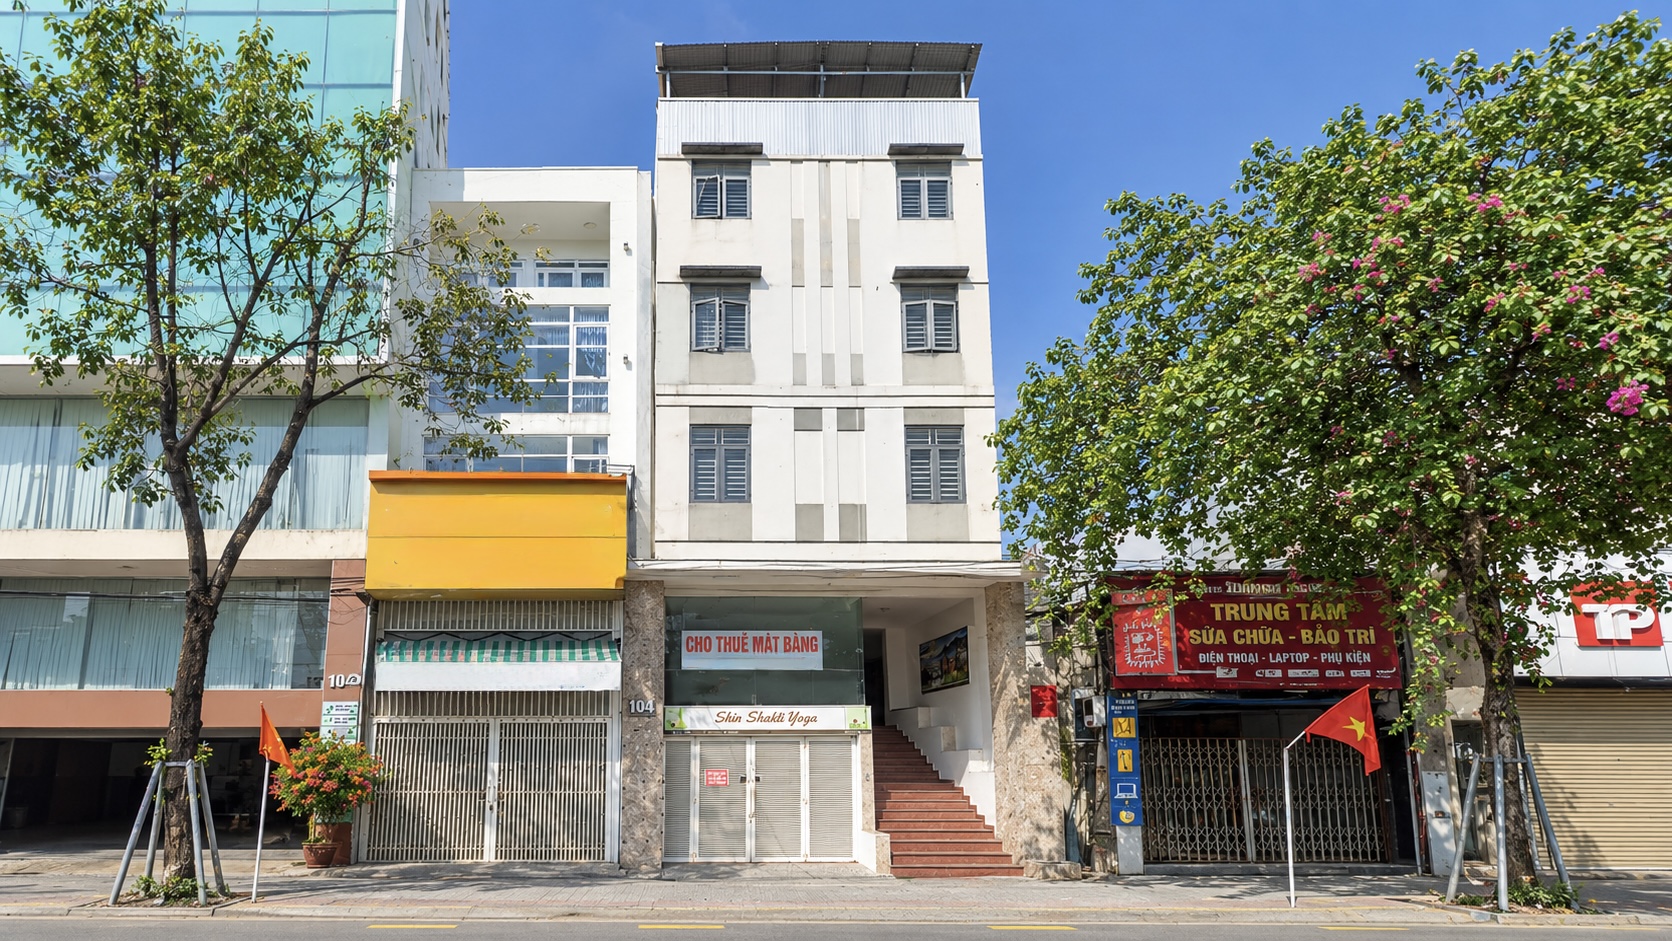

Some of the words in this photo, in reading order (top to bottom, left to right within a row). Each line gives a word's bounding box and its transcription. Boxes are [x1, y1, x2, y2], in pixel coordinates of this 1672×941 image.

[1210, 603, 1289, 620] TRUNG
[1581, 604, 1655, 639] TP
[1233, 626, 1284, 645] CHỮA
[686, 636, 713, 653] CHO
[1227, 653, 1258, 665] THOẠI
[1269, 653, 1310, 663] LAPTOP
[1320, 653, 1342, 665] PHỤ
[629, 699, 655, 713] 104
[715, 711, 742, 723] Shin
[746, 711, 785, 723] Shakti
[788, 711, 818, 727] Yoga
